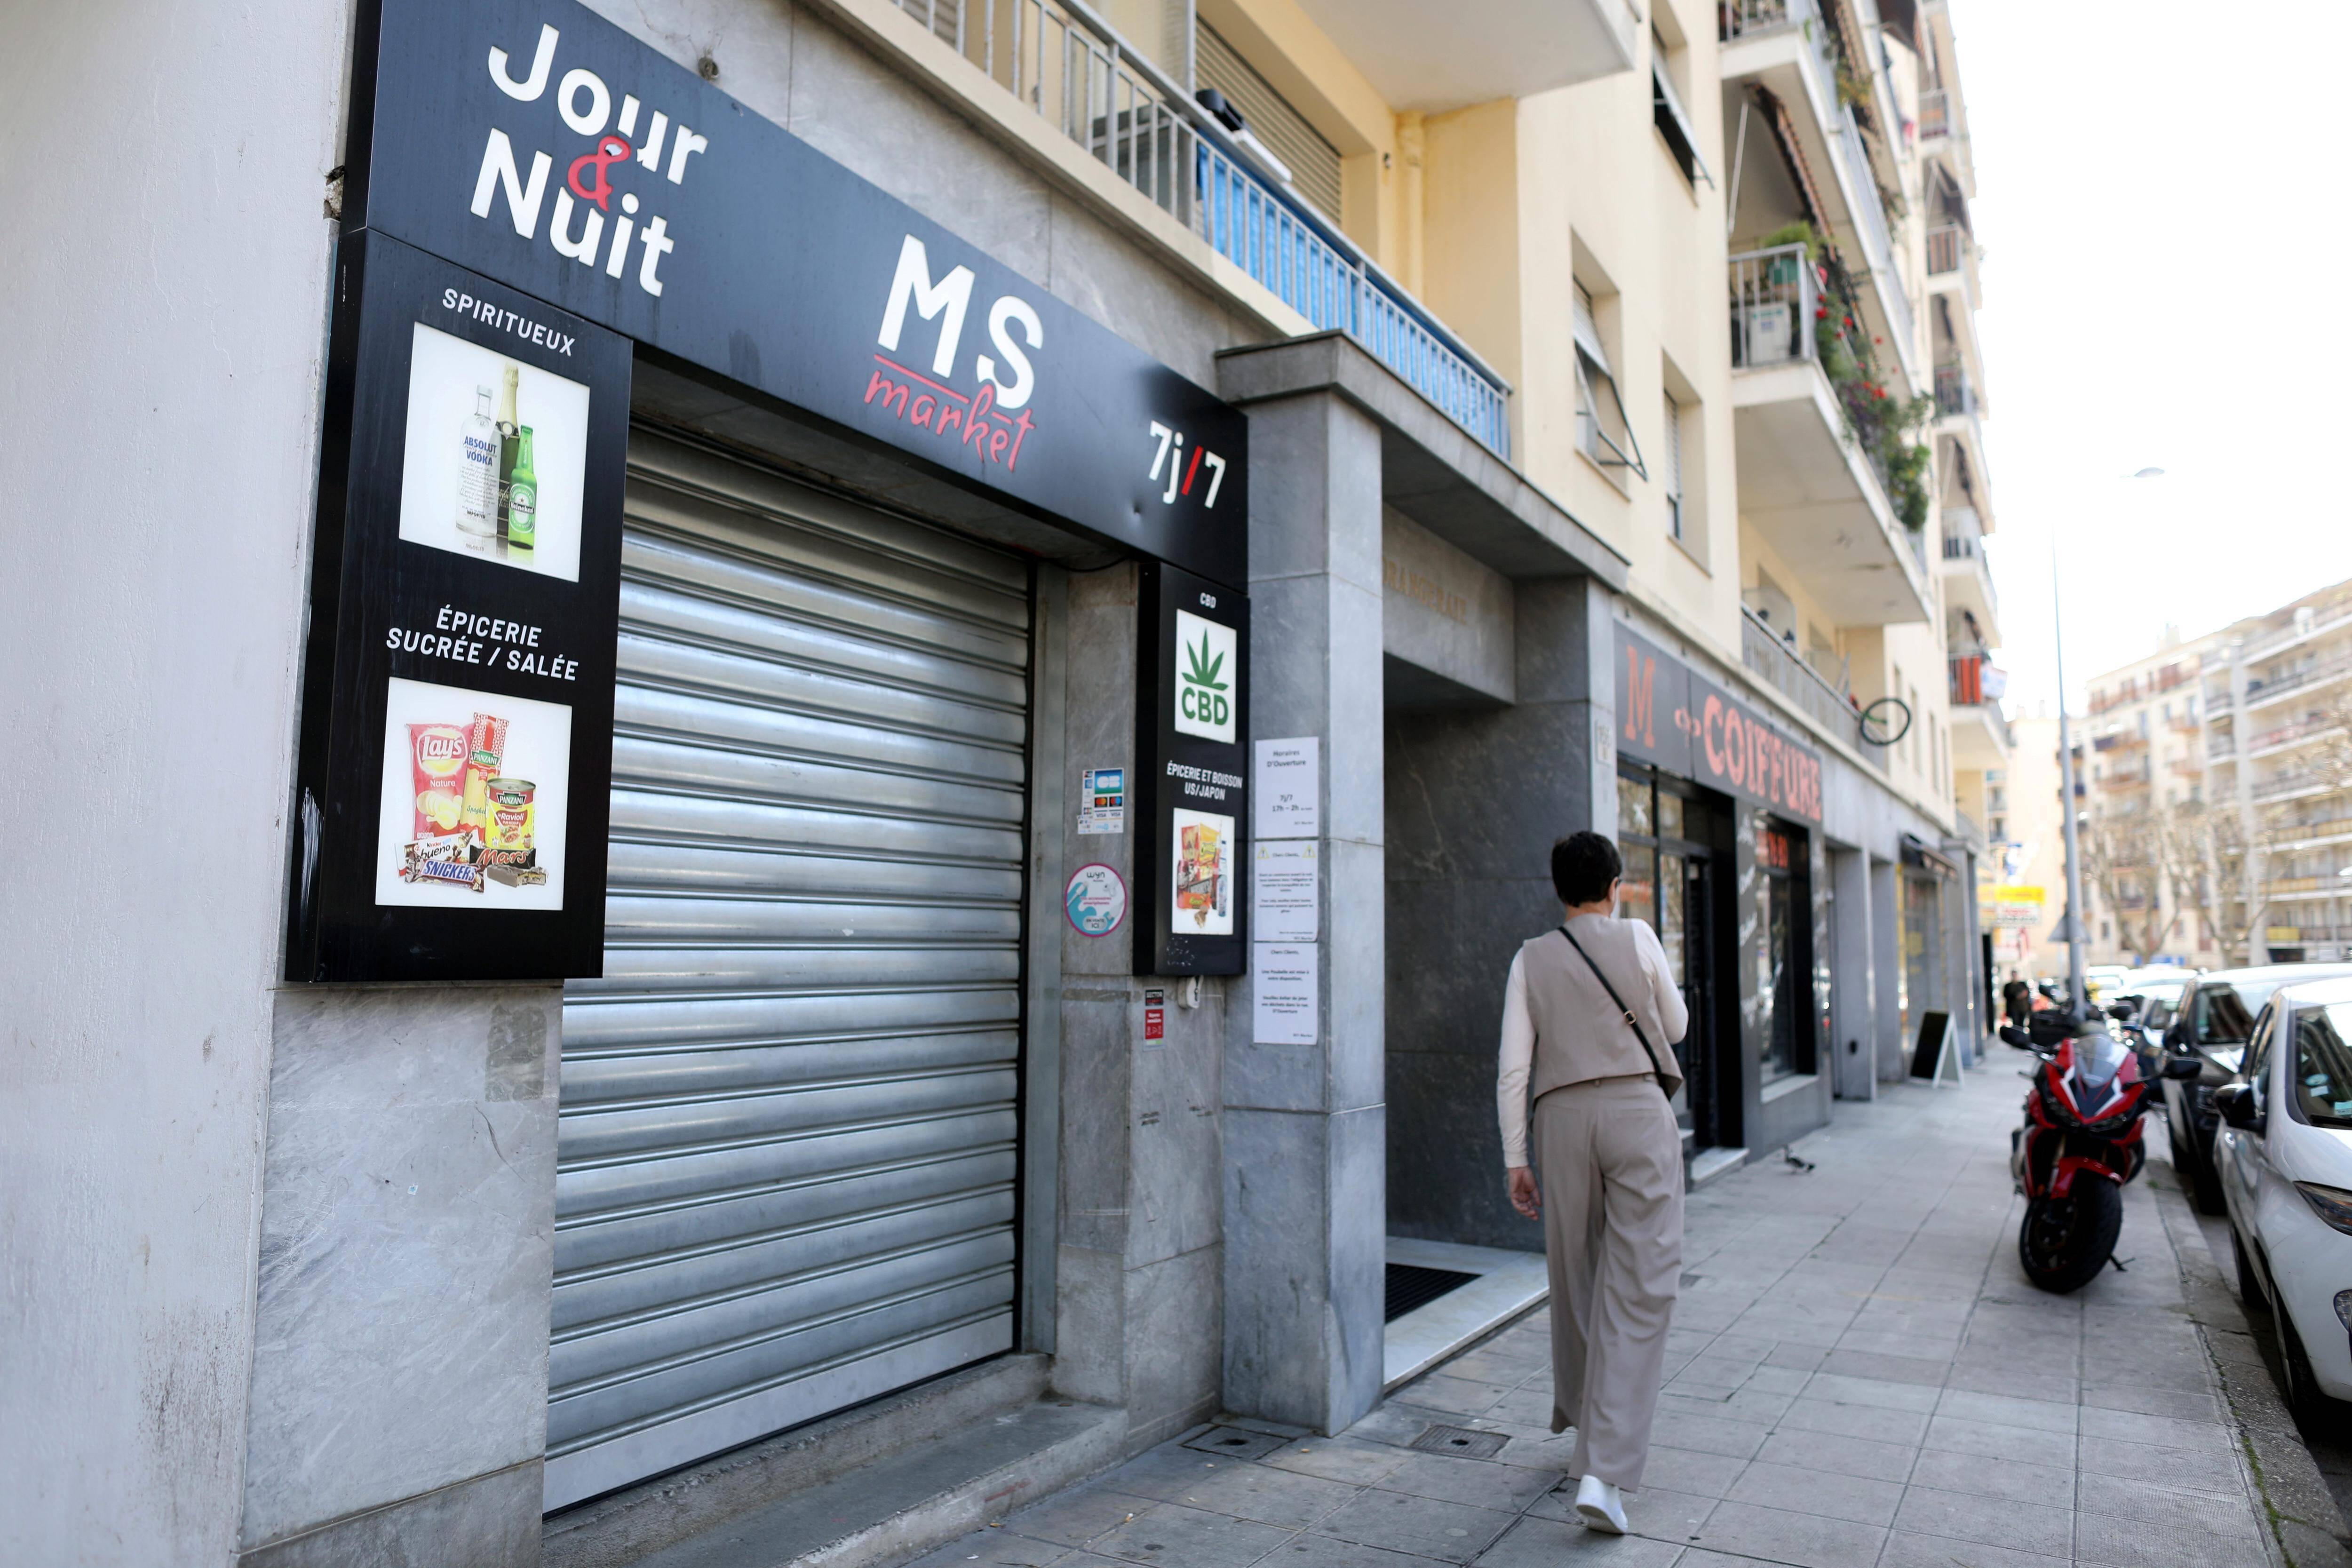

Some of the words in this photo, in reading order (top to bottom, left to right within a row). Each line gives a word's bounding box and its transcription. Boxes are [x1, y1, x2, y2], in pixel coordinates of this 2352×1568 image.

[488, 23, 708, 185] Jour
[568, 135, 631, 212] &
[470, 127, 674, 297] Nuit
[442, 288, 575, 357] SPIRITUEUX
[877, 233, 1043, 409] MS
[864, 369, 1036, 472] market
[464, 436, 497, 454] ABSOLUT
[466, 450, 493, 466] VODKA
[1149, 420, 1226, 509] 7j/7
[510, 501, 533, 514] Heineken
[1200, 592, 1216, 609] CBD
[436, 604, 542, 647] ÉPICERIE
[386, 627, 484, 664] SUCRÉE
[487, 647, 501, 666] /
[507, 649, 579, 681] SALÉE
[1182, 686, 1228, 726] CBD
[1625, 645, 1655, 748] M
[421, 736, 462, 761] Lay's
[473, 752, 497, 765] PANZANI
[1704, 694, 1822, 822] COIFFURE
[1167, 760, 1201, 780] ÉPICERIE
[1201, 770, 1212, 782] ET
[1213, 770, 1242, 789] BOISSON
[1184, 782, 1226, 801] US/JAPON
[500, 796, 523, 804] PANZANI
[424, 861, 477, 881] SNICKERS
[477, 848, 529, 866] Mars
